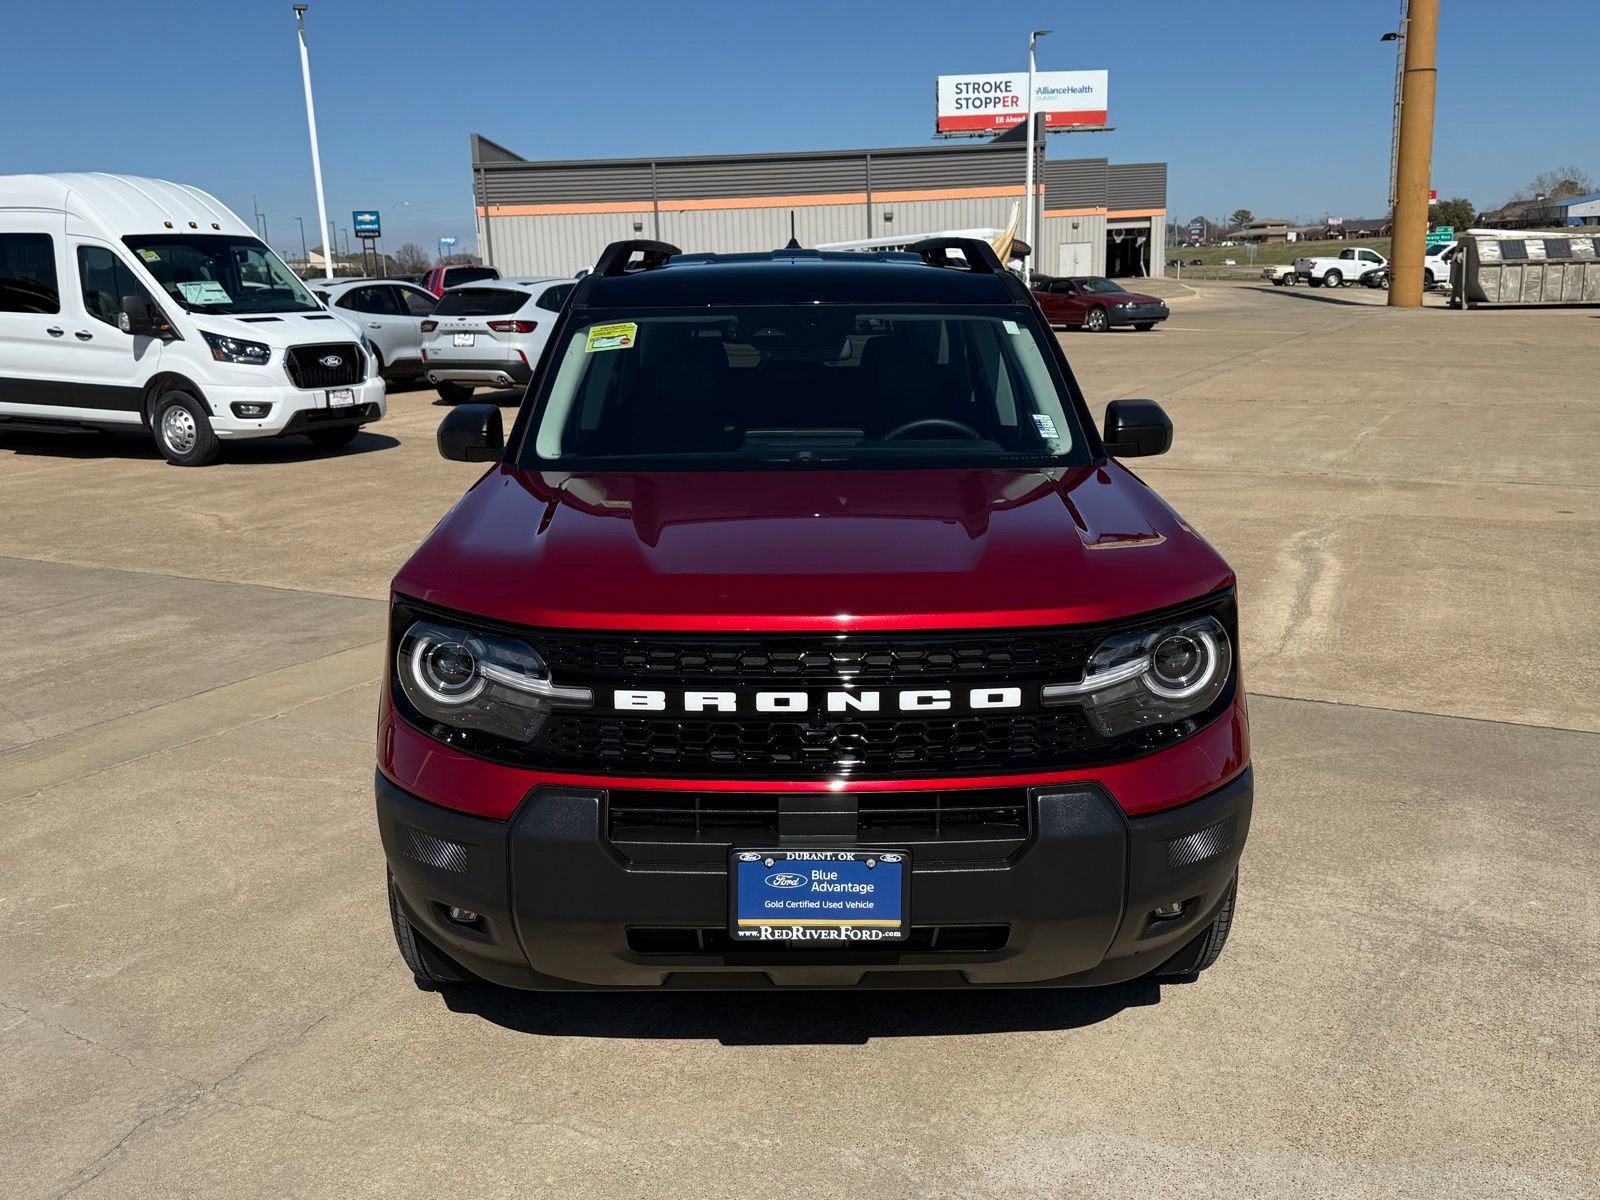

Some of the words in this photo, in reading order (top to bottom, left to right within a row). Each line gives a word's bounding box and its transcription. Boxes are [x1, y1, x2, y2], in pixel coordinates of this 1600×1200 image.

[955, 81, 1012, 95] STROKE
[1037, 85, 1093, 95] AllianceHealth
[955, 96, 1019, 110] STOPPER
[613, 687, 1022, 712] BRONCO
[786, 852, 836, 861] DURANT,
[838, 852, 855, 861] OK
[773, 874, 800, 887] Ford
[811, 869, 838, 881] Blue
[811, 881, 874, 894] Advantage
[764, 900, 783, 908] Gold
[786, 900, 820, 909] Certified
[822, 900, 843, 909] Used
[844, 900, 874, 909] Vehicle
